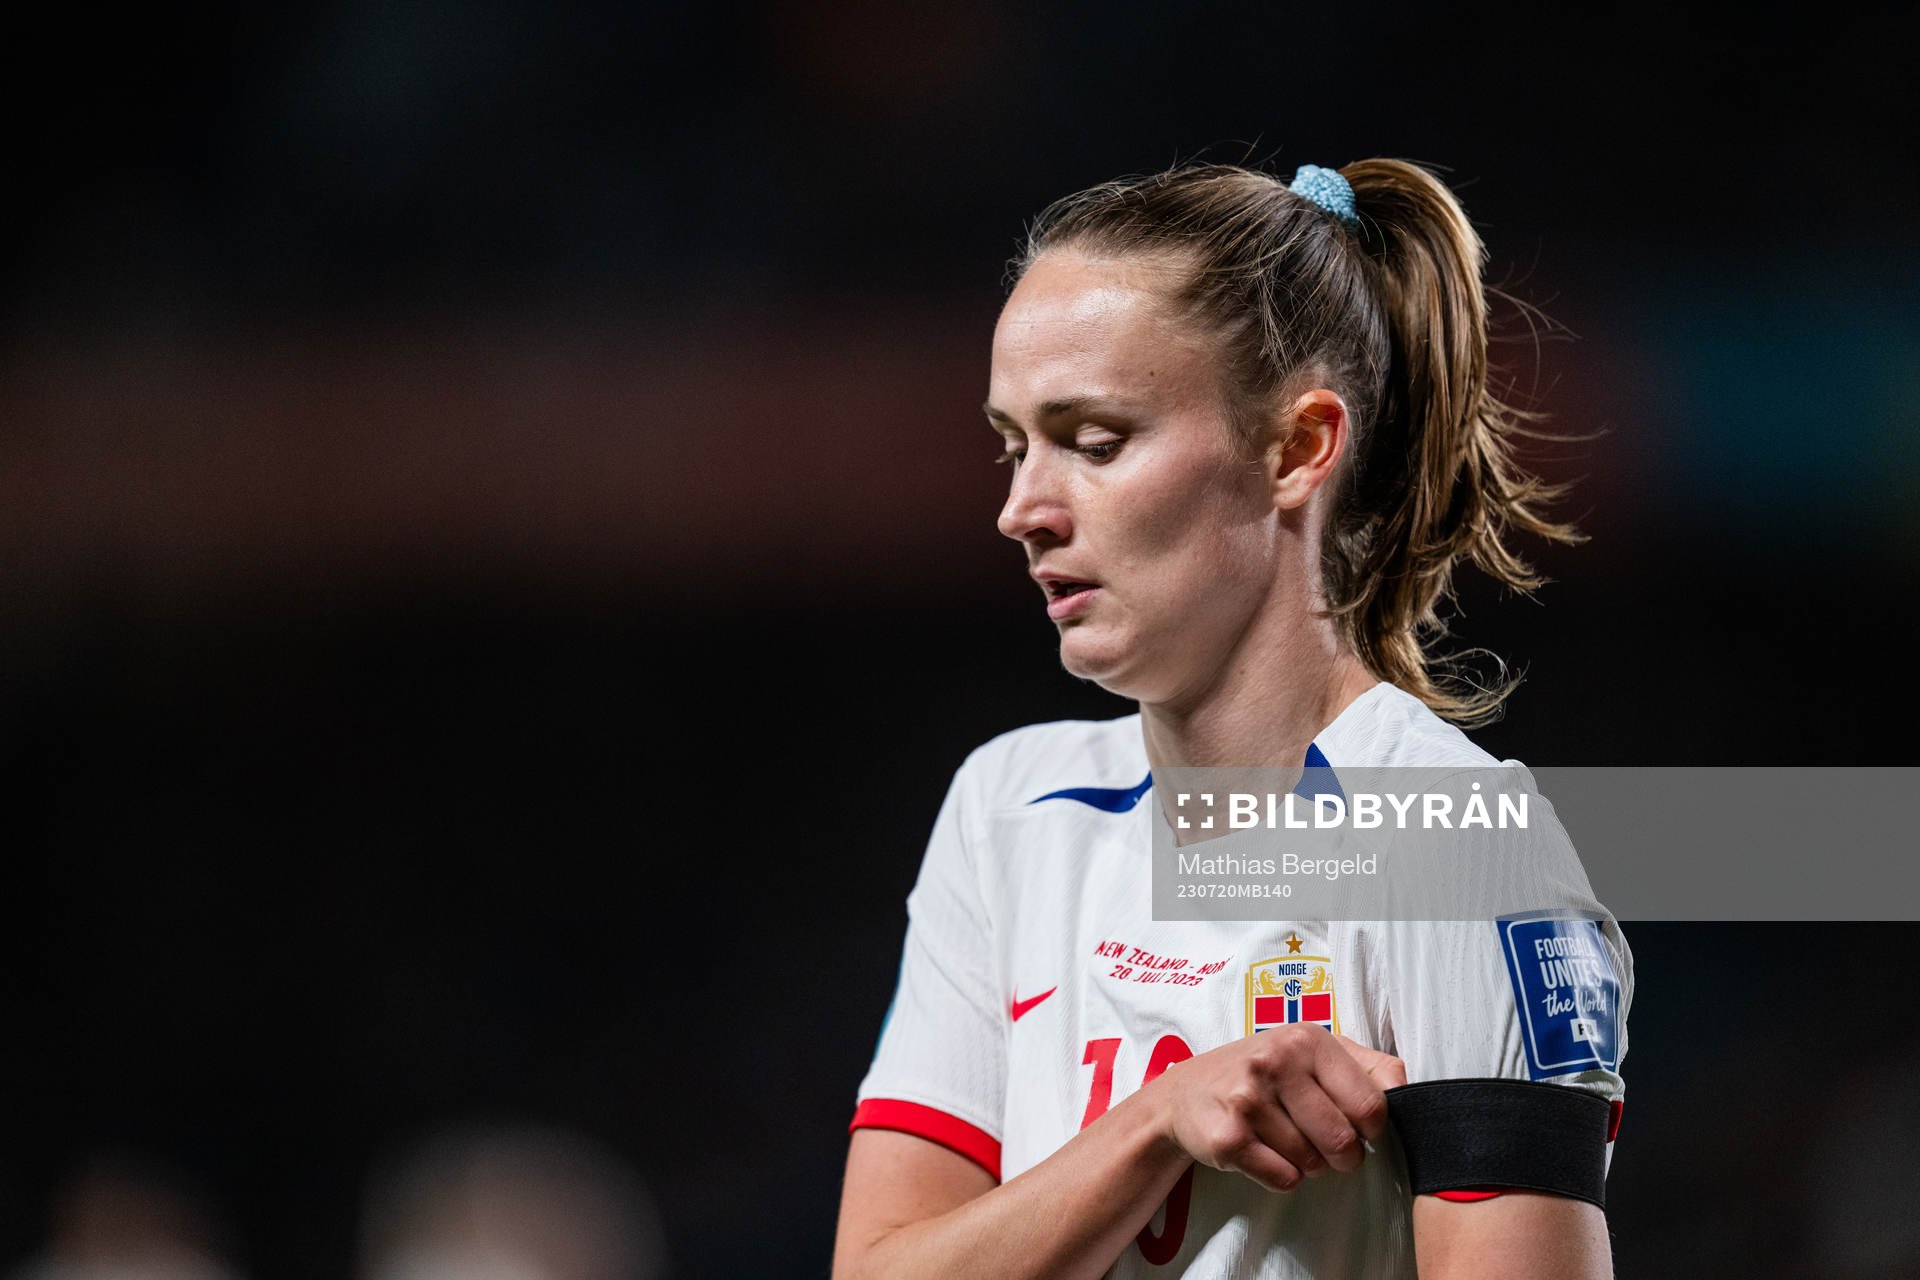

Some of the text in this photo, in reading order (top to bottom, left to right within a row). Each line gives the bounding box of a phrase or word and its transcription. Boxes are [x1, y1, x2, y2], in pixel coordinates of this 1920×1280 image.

[1094, 940, 1128, 958] NEW
[1126, 947, 1188, 970] ZEALAND
[1196, 955, 1234, 975] NOR
[1534, 937, 1596, 960] FOOTBALL
[1164, 972, 1204, 987] 2023
[1279, 963, 1307, 976] NORGE
[1540, 958, 1603, 990] UNITES
[1541, 990, 1575, 1018] the
